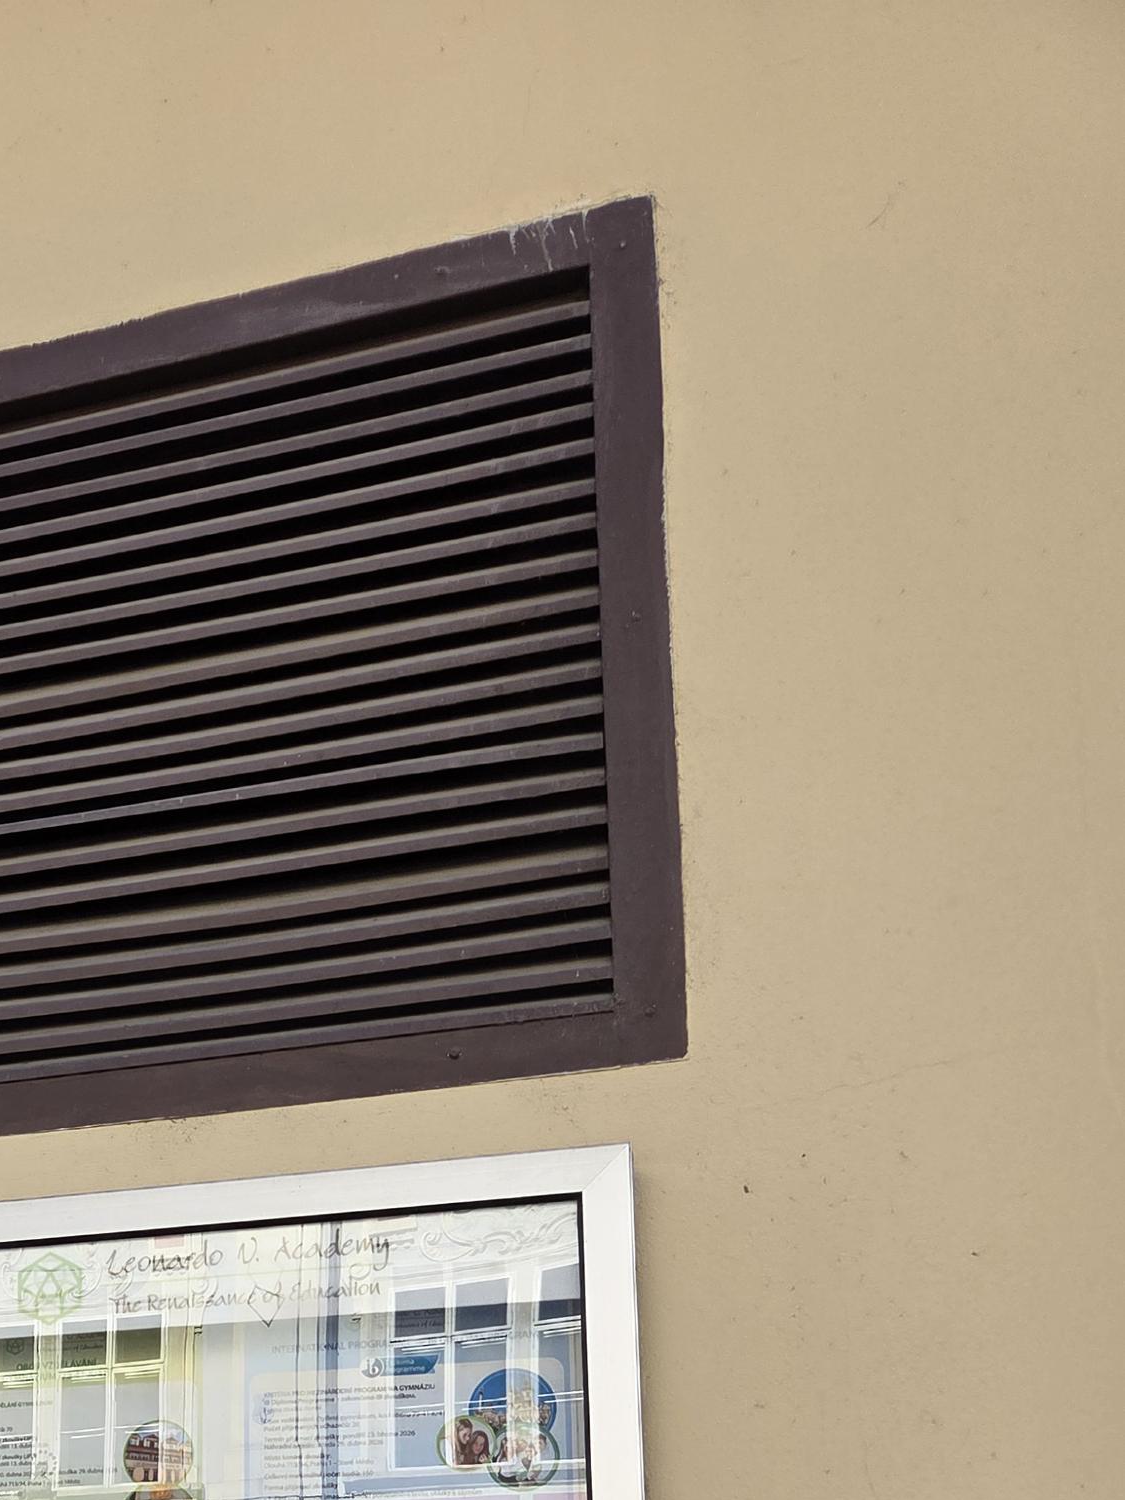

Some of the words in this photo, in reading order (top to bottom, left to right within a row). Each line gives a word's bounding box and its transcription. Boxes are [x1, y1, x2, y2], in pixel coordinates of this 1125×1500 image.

[107, 1240, 222, 1277] Leonardo
[275, 1229, 390, 1271] Academy
[148, 1290, 250, 1311] Renaissance
[289, 1281, 380, 1300] Education
